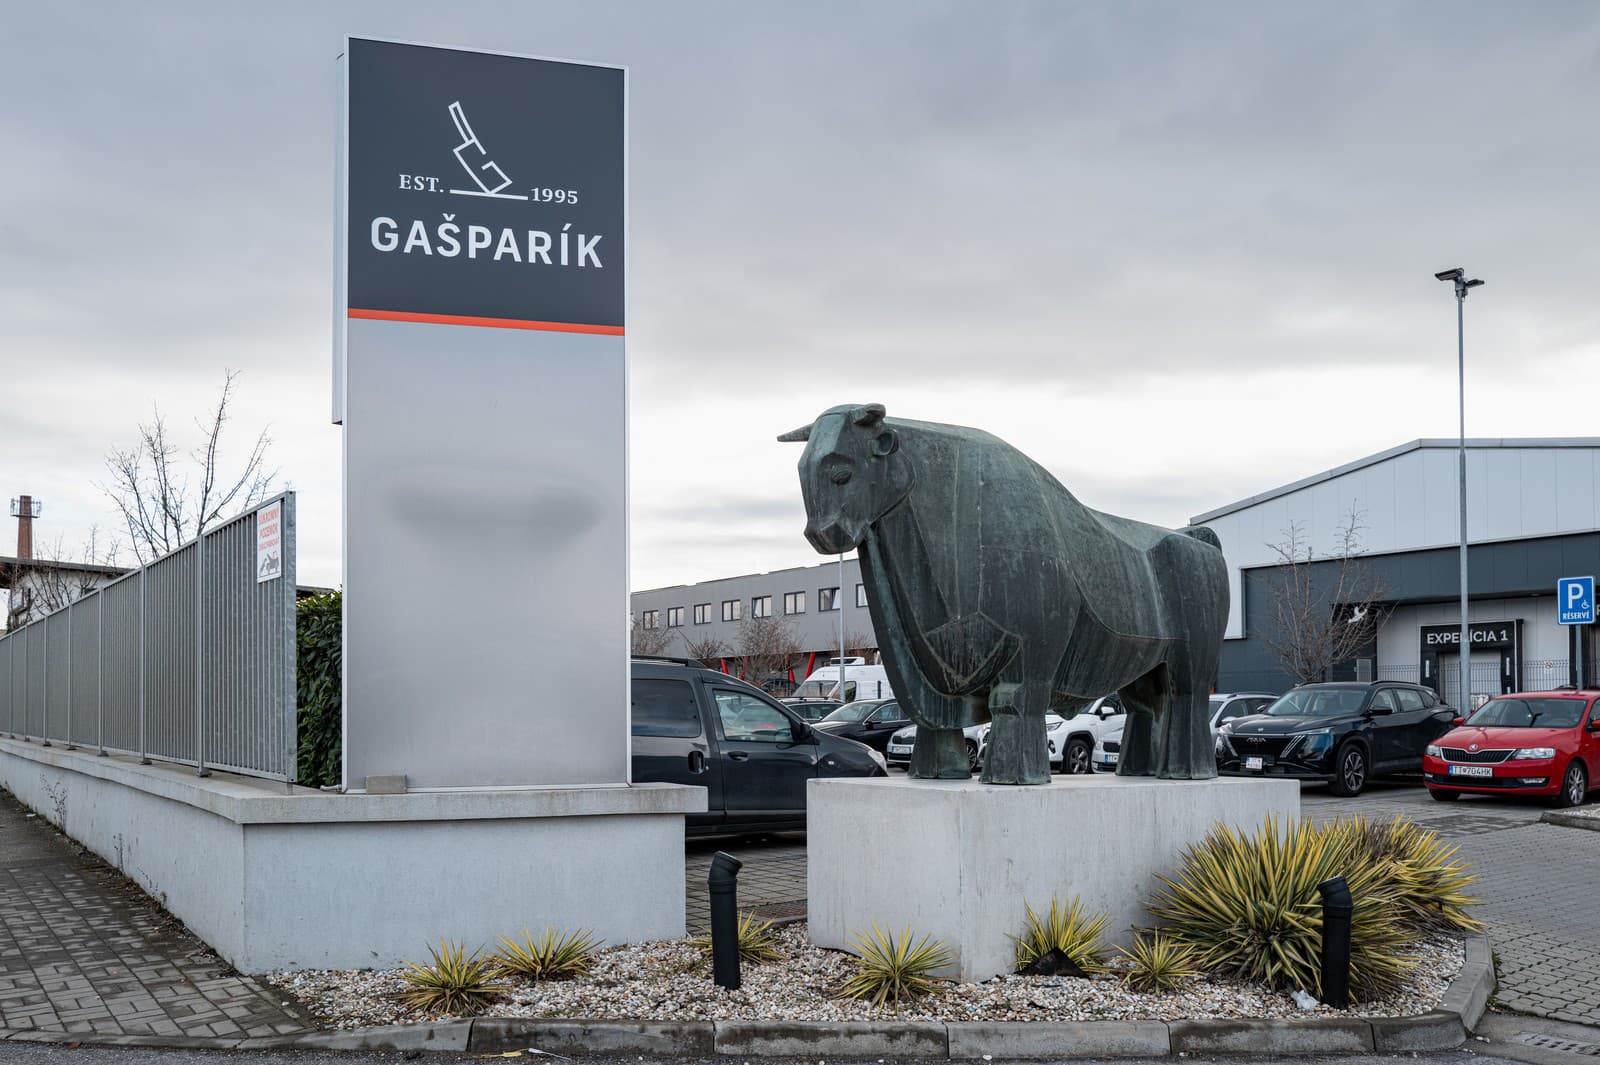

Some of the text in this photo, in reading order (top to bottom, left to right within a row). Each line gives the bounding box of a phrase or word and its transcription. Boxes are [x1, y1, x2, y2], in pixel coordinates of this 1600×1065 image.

[399, 174, 578, 204] EST. 1995
[371, 213, 603, 268] GAŠPARÍK
[1567, 583, 1584, 609] P
[1426, 628, 1508, 644] EXPEÍCIA 1
